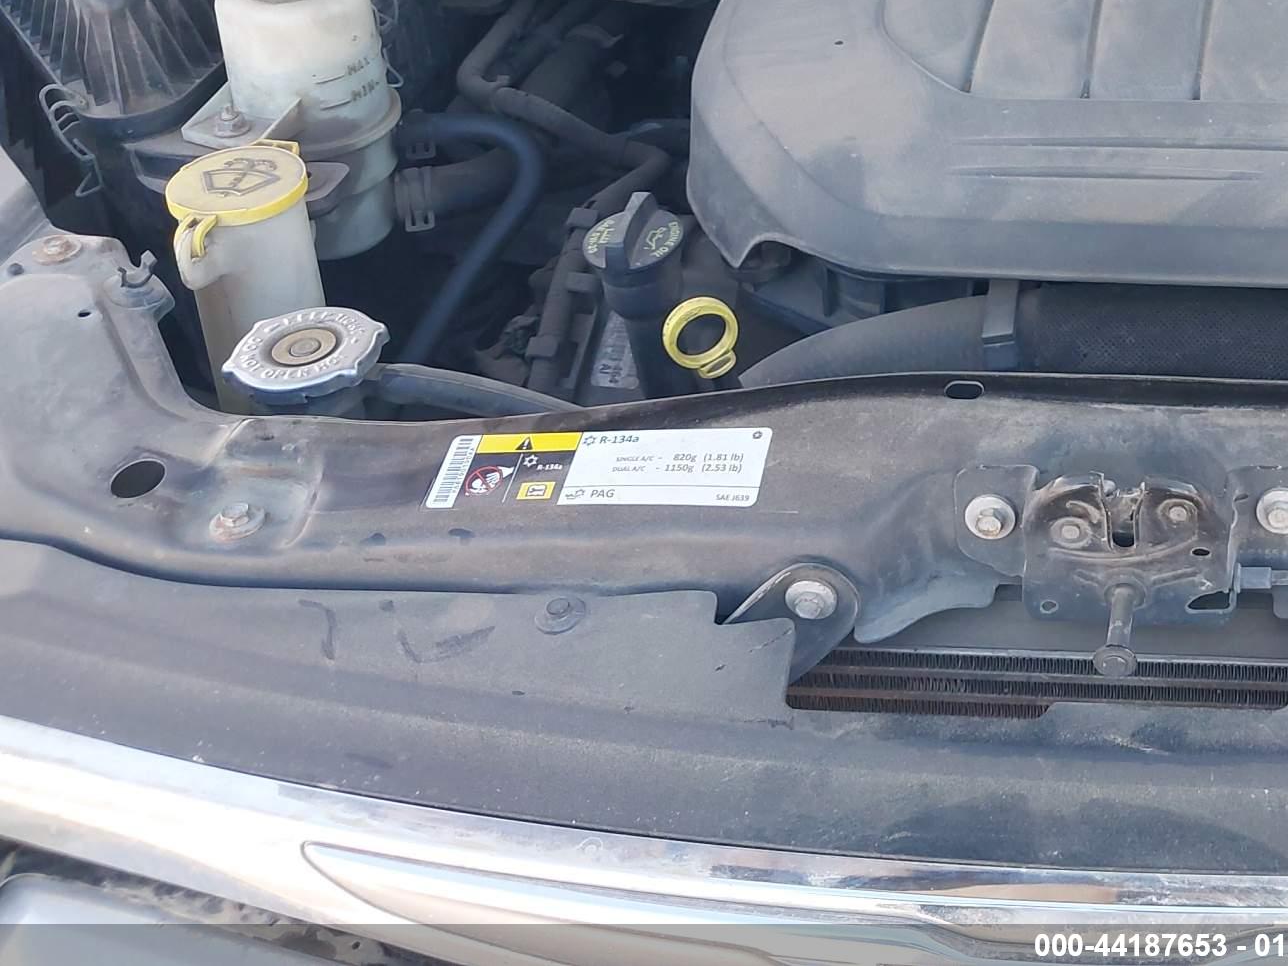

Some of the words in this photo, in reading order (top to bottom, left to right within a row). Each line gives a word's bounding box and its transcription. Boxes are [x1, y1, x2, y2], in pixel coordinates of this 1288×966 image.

[599, 434, 641, 445] R-134a
[673, 453, 697, 463] 820g
[703, 453, 728, 462] (1.81
[730, 452, 744, 462] lb)
[664, 464, 694, 473] 1150g
[701, 464, 727, 472] (2.53
[728, 463, 743, 473] lb)
[590, 488, 616, 499] PAG
[715, 493, 730, 501] SAE
[730, 494, 750, 502] J639
